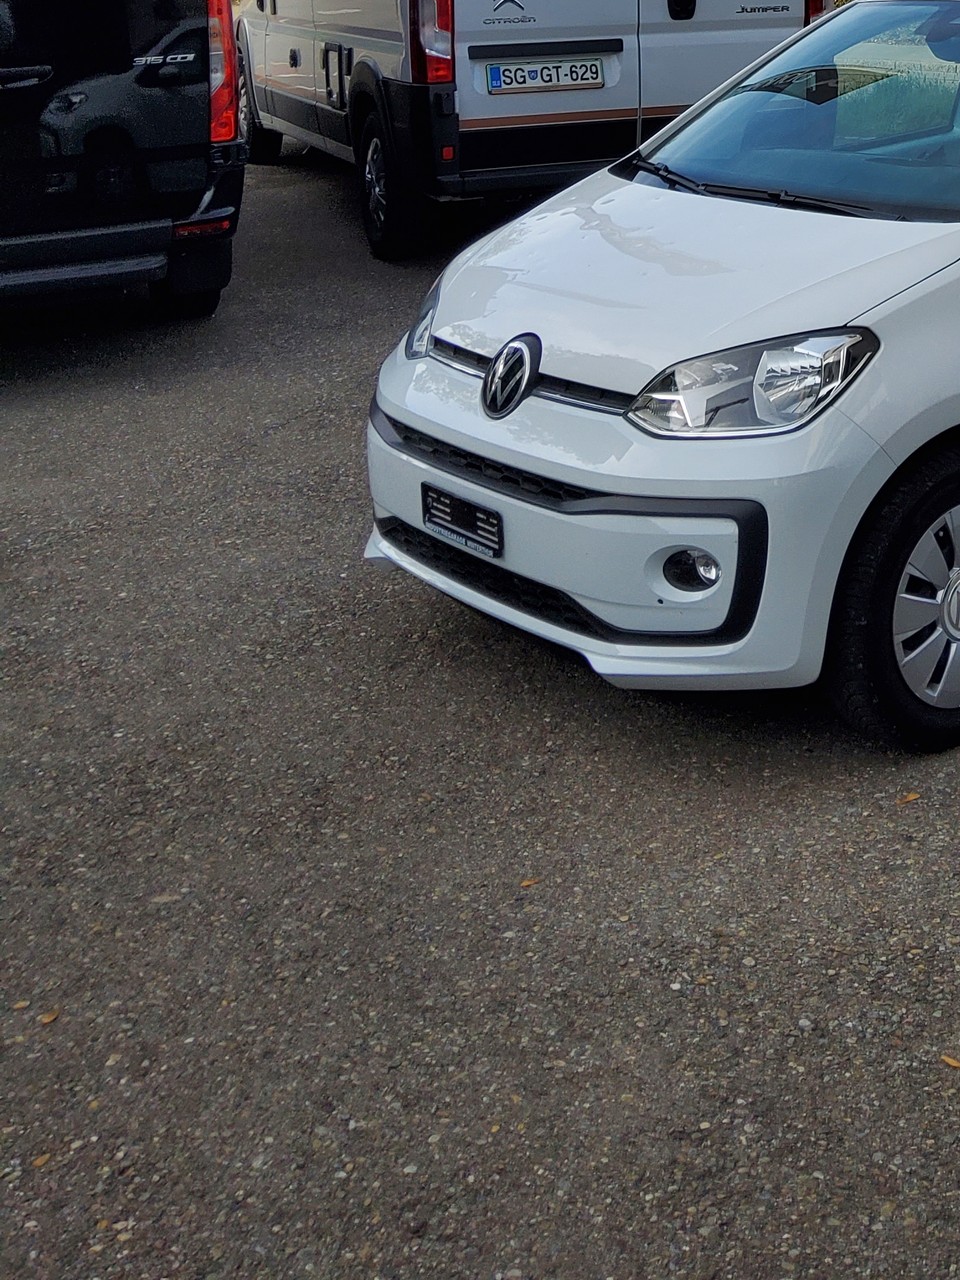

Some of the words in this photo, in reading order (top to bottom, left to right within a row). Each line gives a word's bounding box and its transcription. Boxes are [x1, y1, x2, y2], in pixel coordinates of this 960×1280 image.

[132, 55, 165, 66] 315
[166, 53, 196, 63] CDI
[501, 67, 527, 86] SG
[540, 63, 600, 83] GT-629
